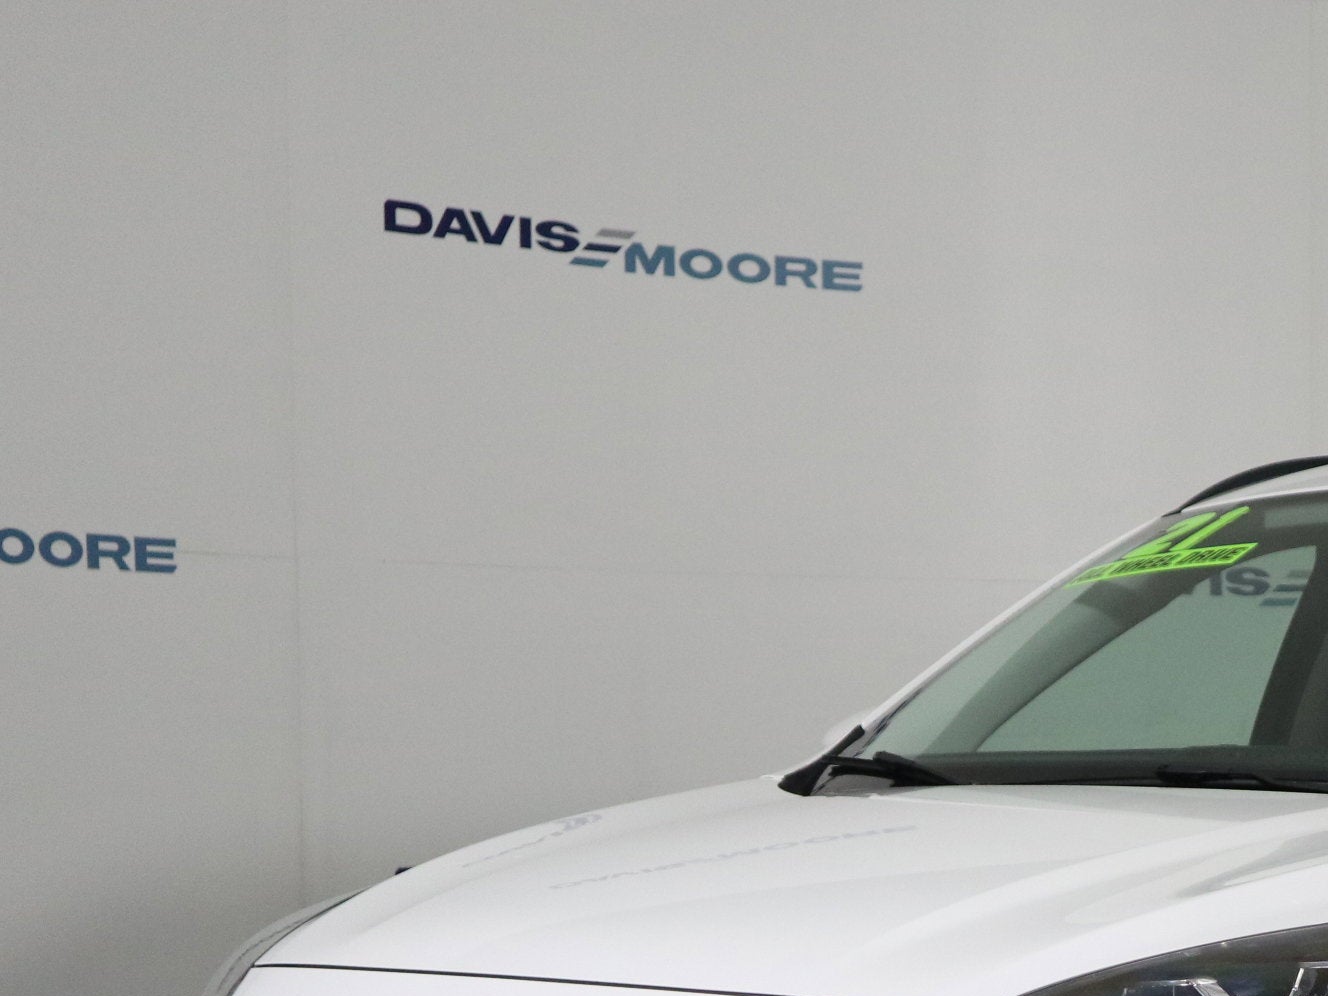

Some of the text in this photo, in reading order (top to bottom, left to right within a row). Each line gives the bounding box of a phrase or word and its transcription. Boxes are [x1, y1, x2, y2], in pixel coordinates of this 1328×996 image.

[384, 199, 863, 292] DAVIS MOORE
[1121, 505, 1250, 560] 21
[1174, 546, 1250, 566] DRIVE
